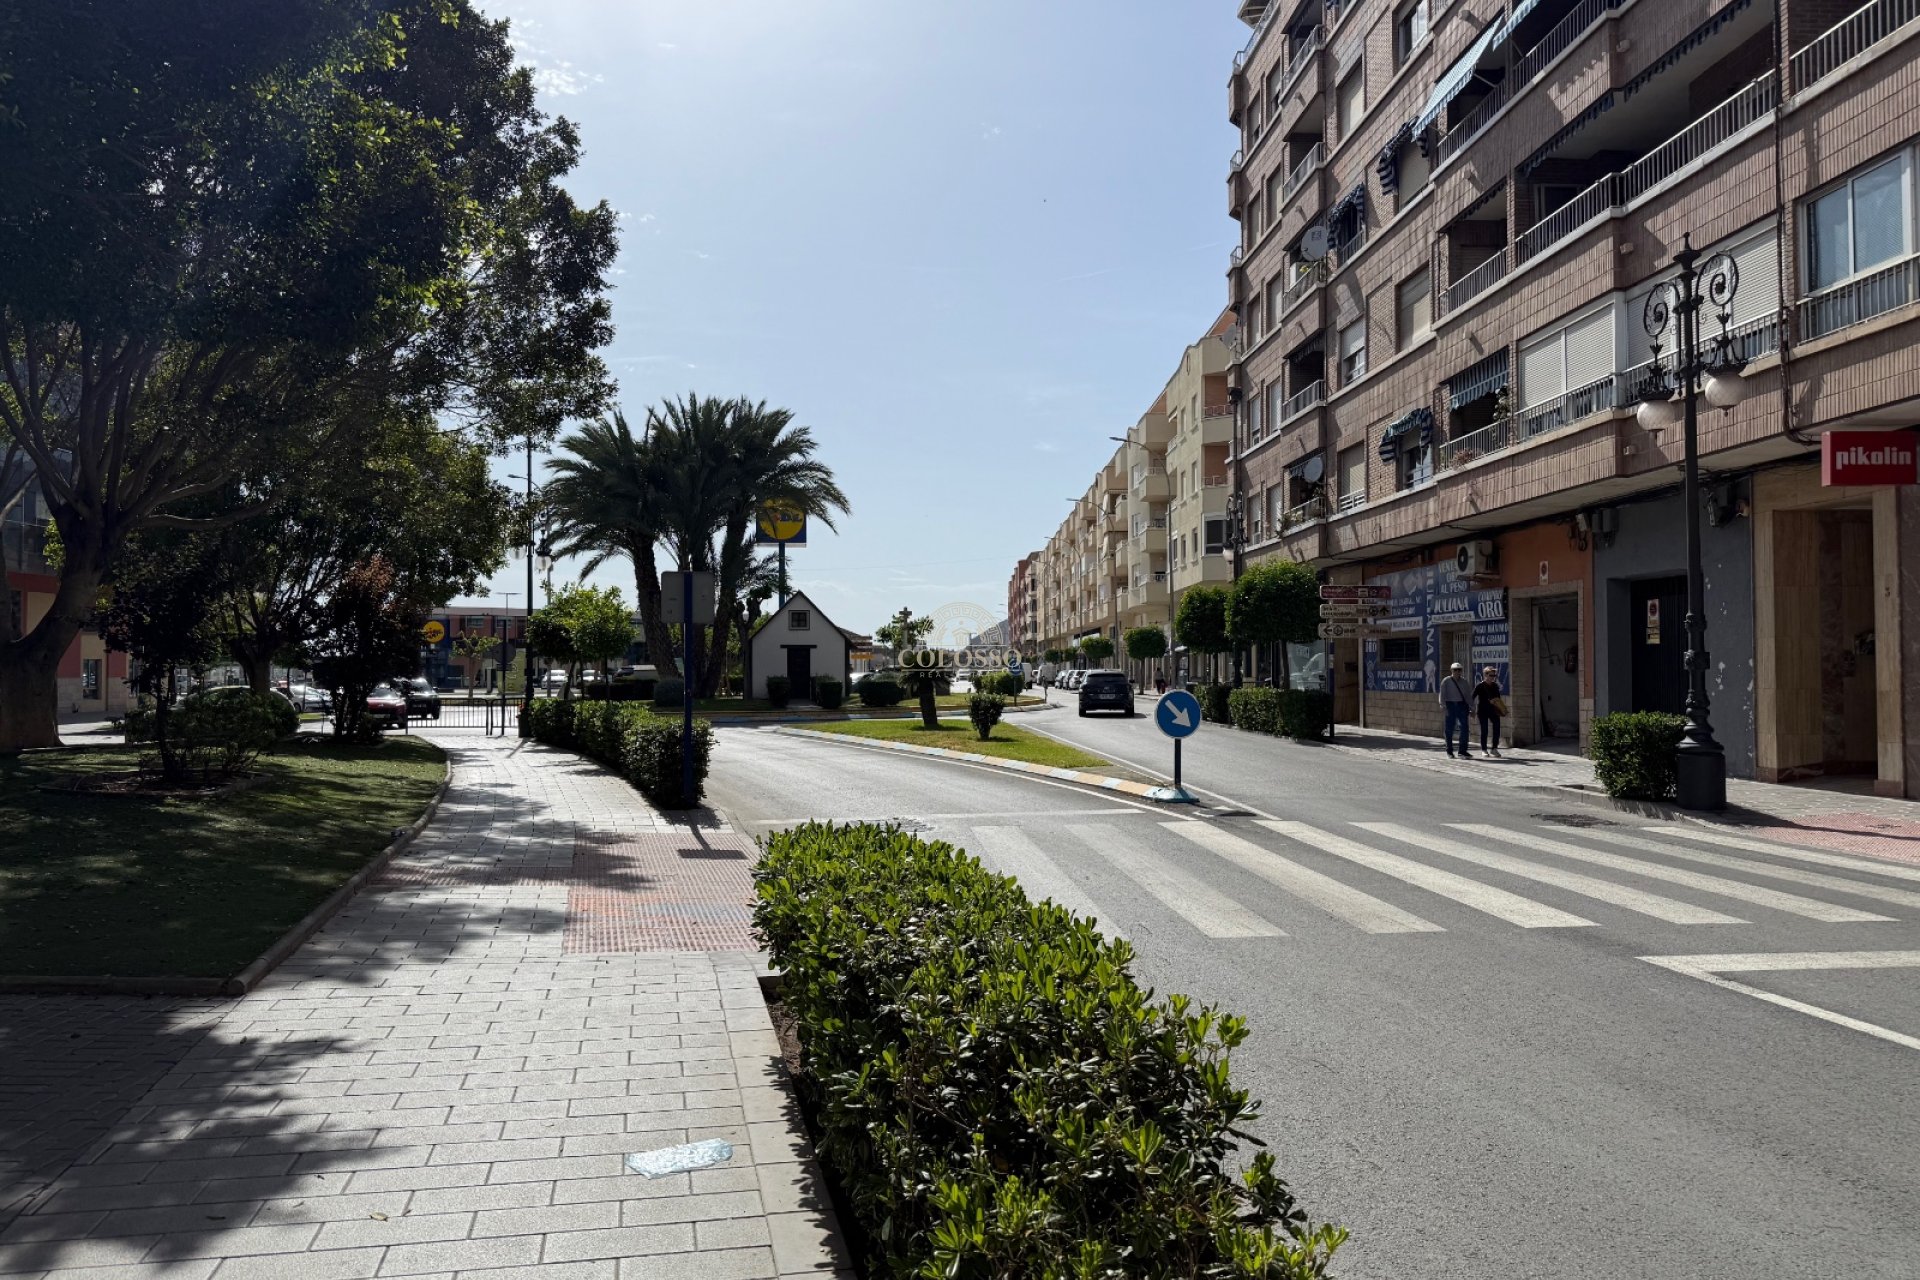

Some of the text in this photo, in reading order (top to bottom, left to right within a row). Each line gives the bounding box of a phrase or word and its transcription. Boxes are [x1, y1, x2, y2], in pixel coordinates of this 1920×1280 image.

[1835, 446, 1911, 471] pikolin
[1441, 580, 1467, 594] AL PESO
[1478, 590, 1503, 602] COMPRO
[1434, 596, 1470, 614] JULIANA
[1478, 600, 1504, 618] ORO
